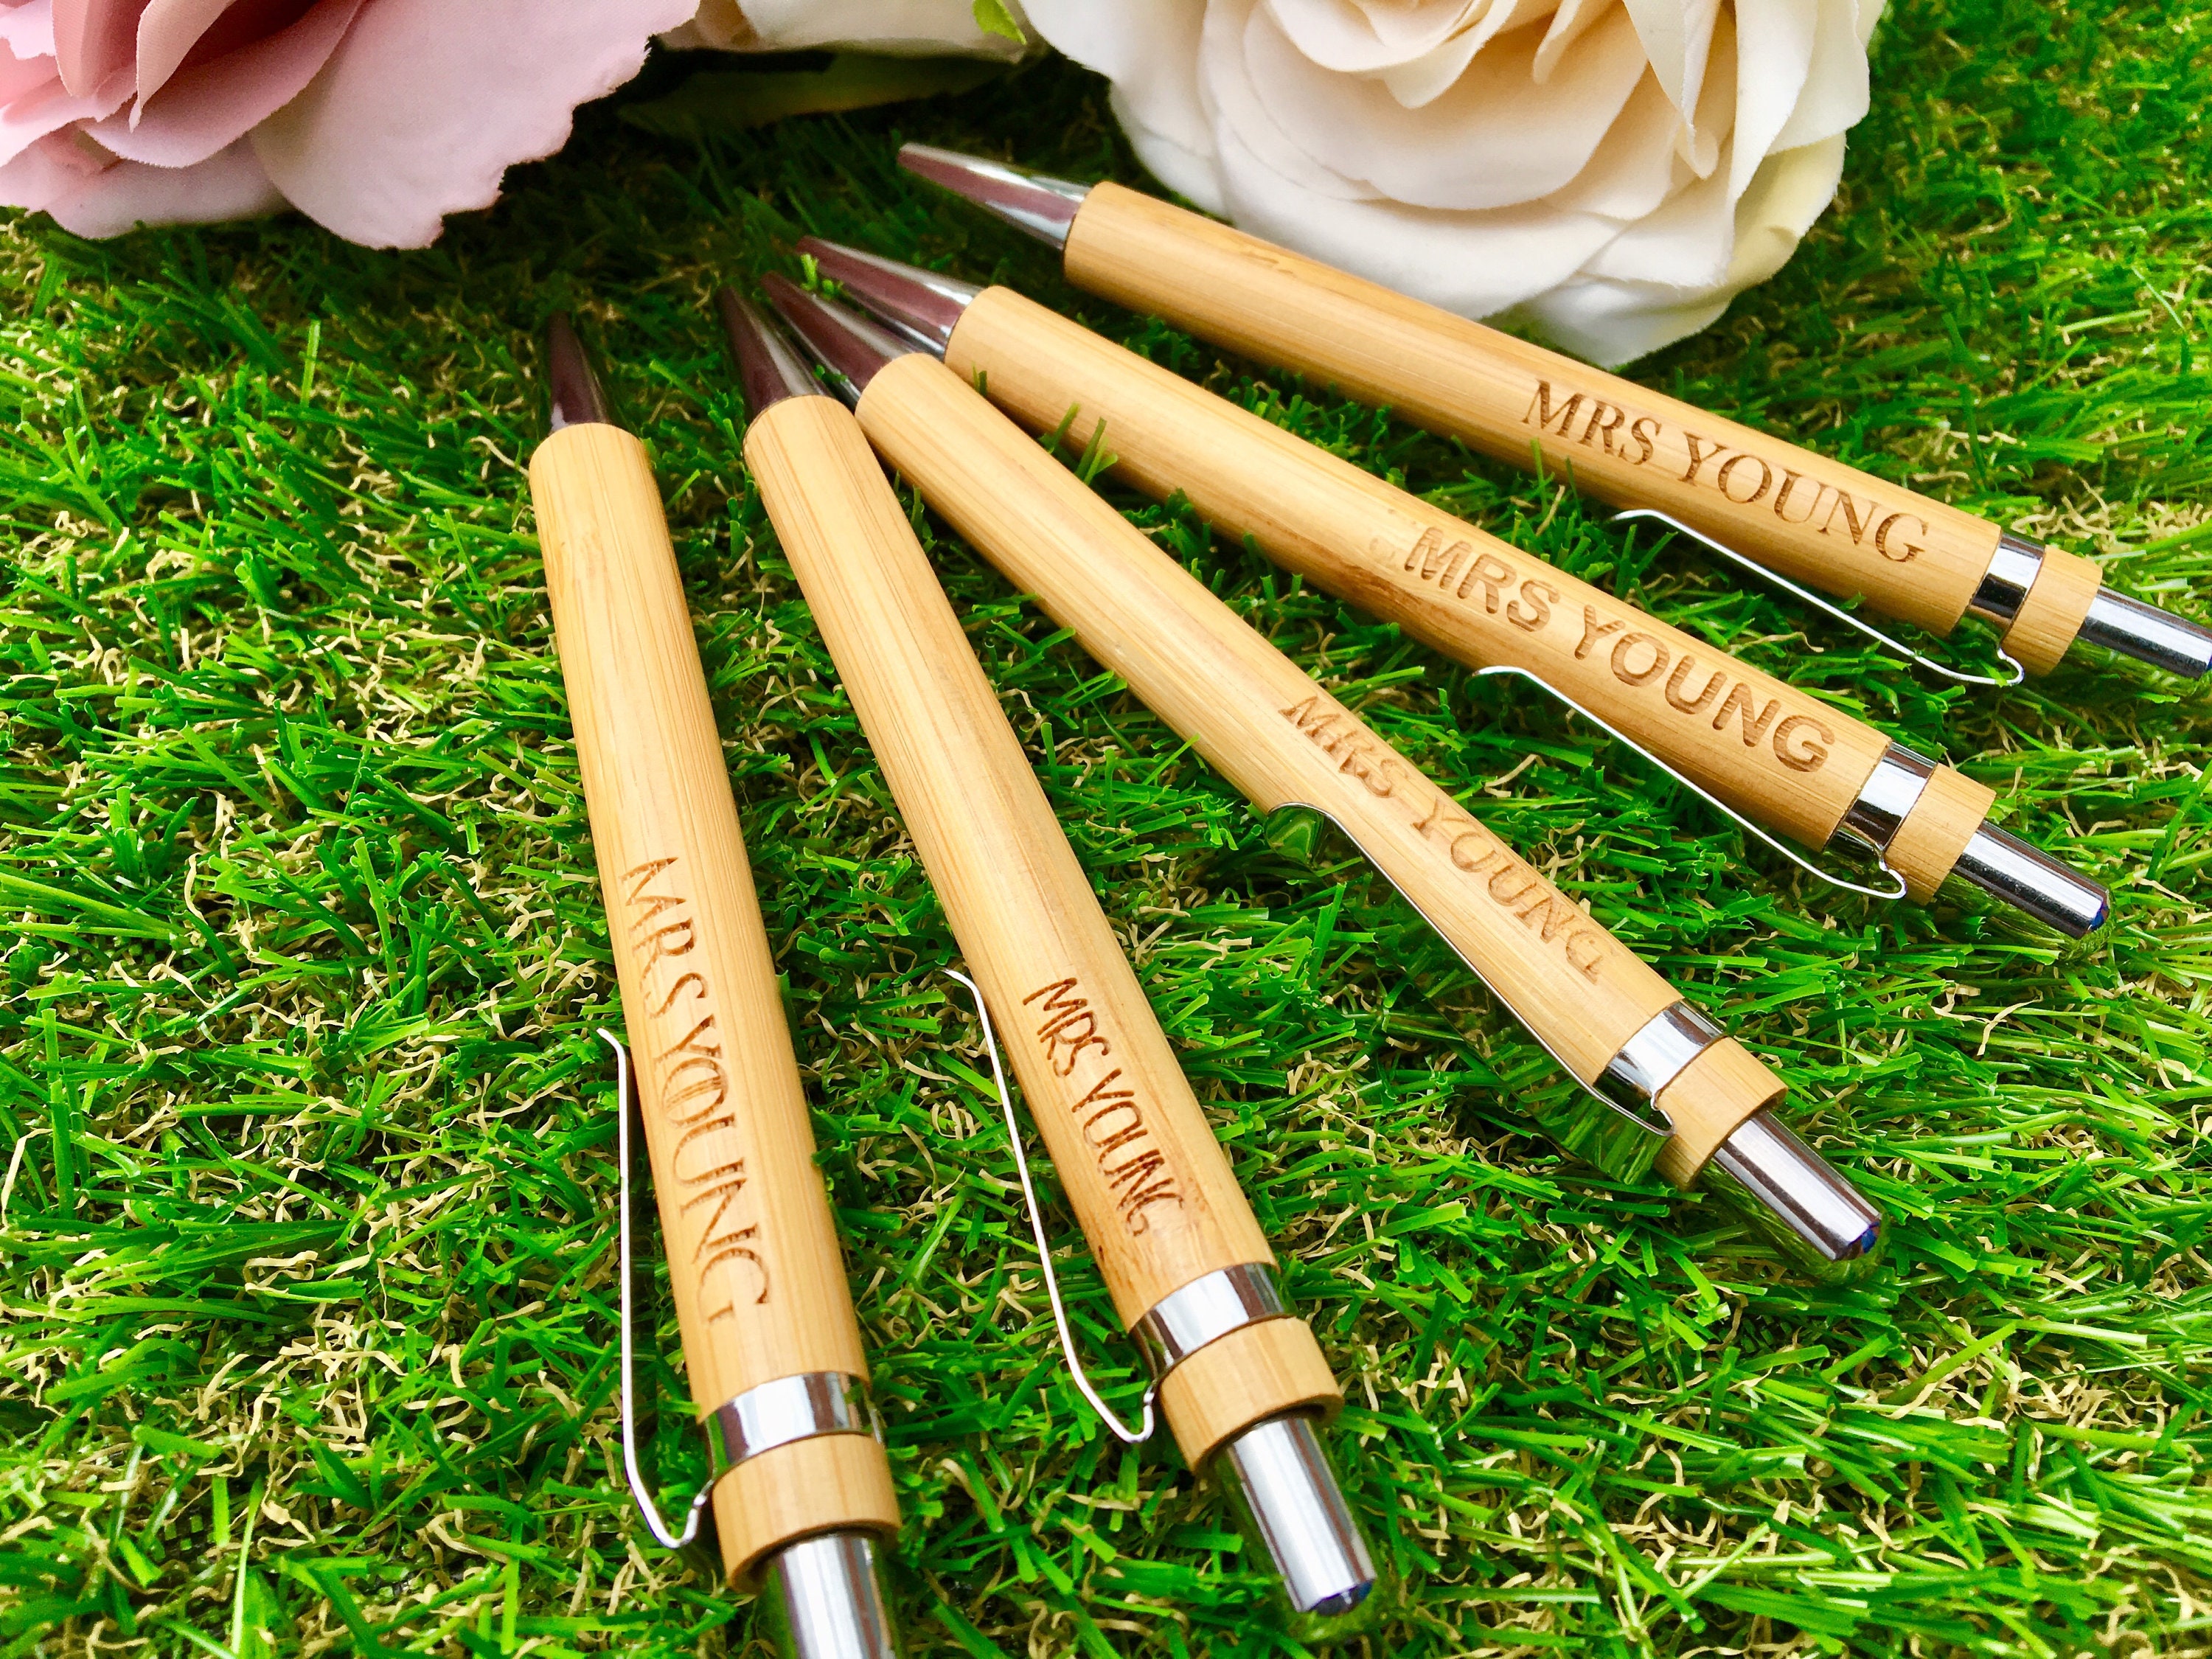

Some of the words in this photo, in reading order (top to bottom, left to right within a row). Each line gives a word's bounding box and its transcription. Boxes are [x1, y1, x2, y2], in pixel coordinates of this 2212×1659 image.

[1523, 379, 1661, 466] MRS
[1677, 431, 1930, 563] YOUNG
[1403, 526, 1559, 633] MRS
[1573, 605, 1836, 773] YOUNG
[619, 856, 709, 1020] MRS
[1278, 695, 1408, 798] MRS
[1410, 795, 1619, 984] YOUNG
[653, 1014, 772, 1324] YOUNG
[1023, 977, 1110, 1078] MRS
[1071, 1068, 1184, 1237] YOUNG
